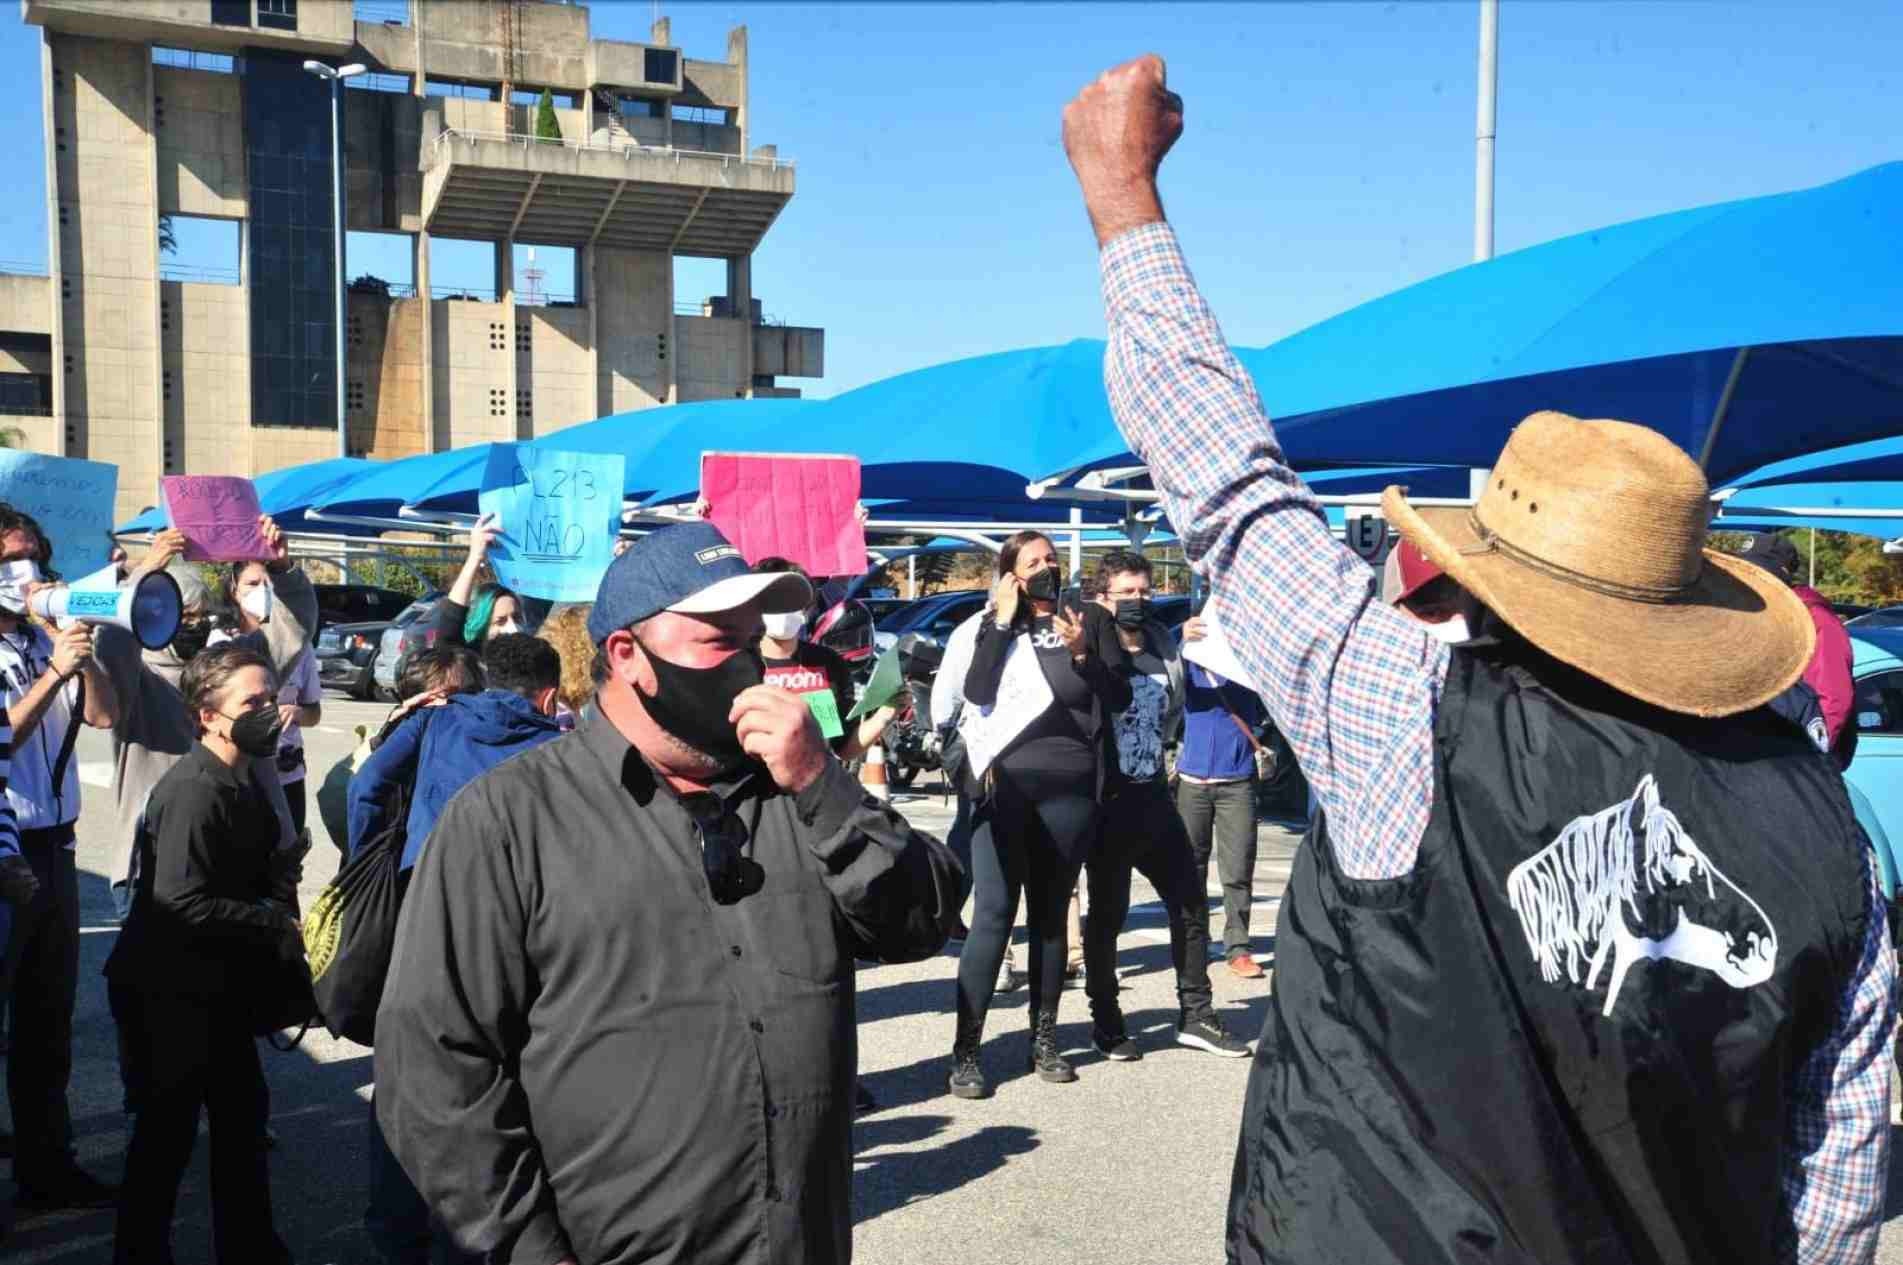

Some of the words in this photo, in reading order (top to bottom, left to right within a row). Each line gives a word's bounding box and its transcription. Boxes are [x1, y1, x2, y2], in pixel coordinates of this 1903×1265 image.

[524, 514, 586, 555] NÃO
[1360, 514, 1373, 548] E
[763, 670, 824, 689] enom
